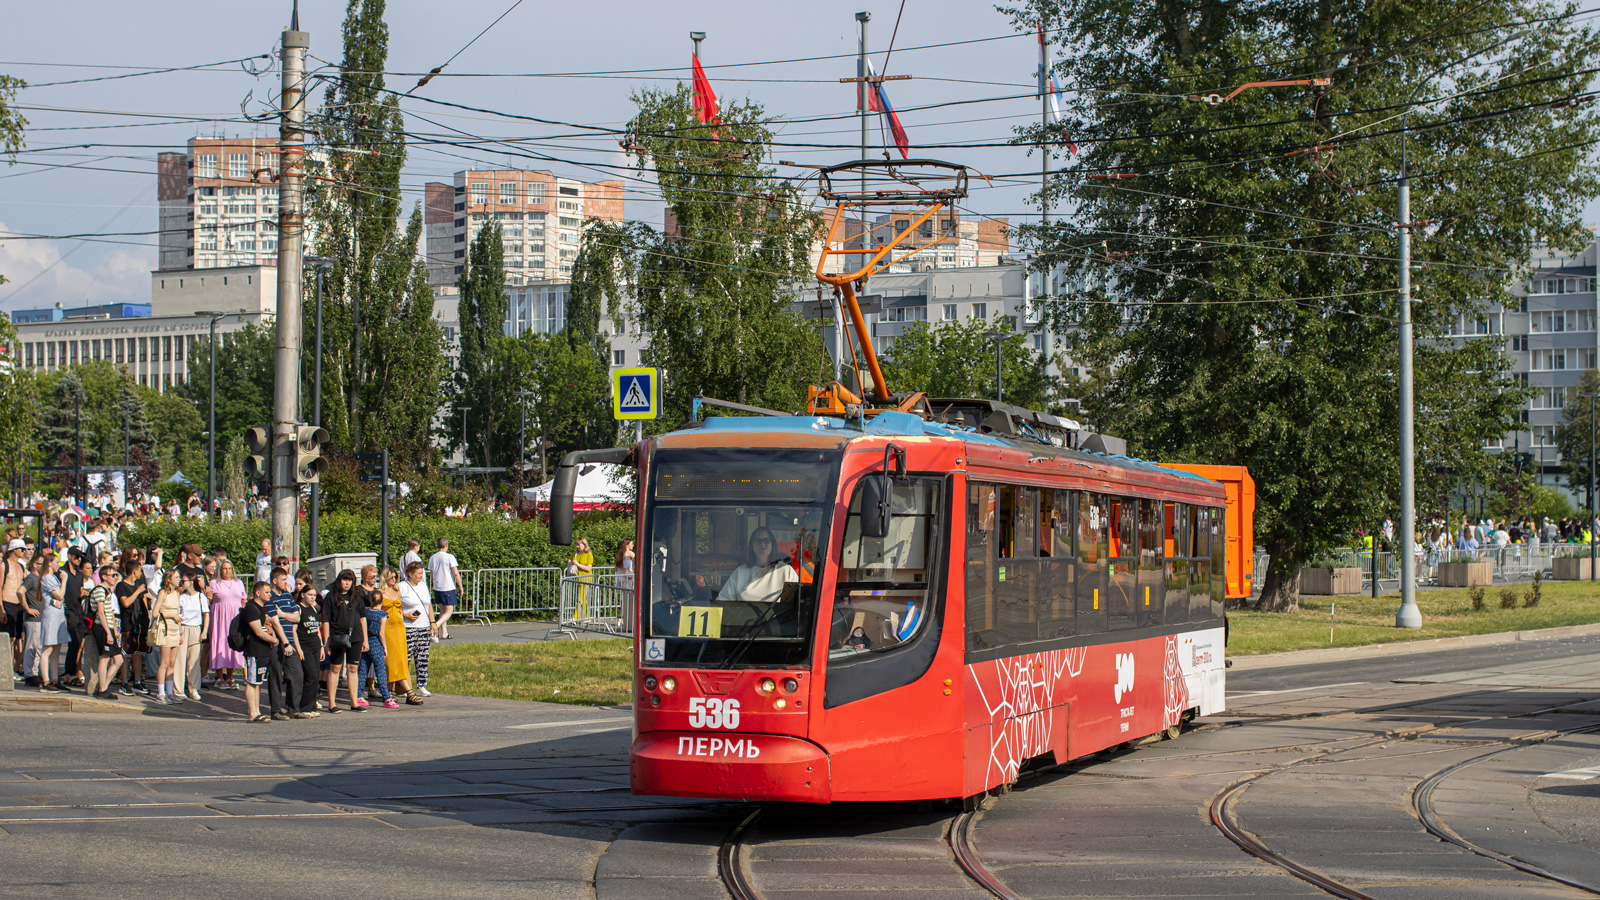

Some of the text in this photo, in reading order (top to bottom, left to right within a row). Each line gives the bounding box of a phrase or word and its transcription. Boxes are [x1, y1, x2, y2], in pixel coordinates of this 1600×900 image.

[81, 327, 129, 336] БИБЛИОТЕКА
[179, 322, 220, 331] ГОРЬКОО
[1089, 505, 1100, 530] 536
[686, 611, 710, 638] 11
[688, 697, 740, 729] 536
[677, 736, 761, 758] ПЕРМЬ
